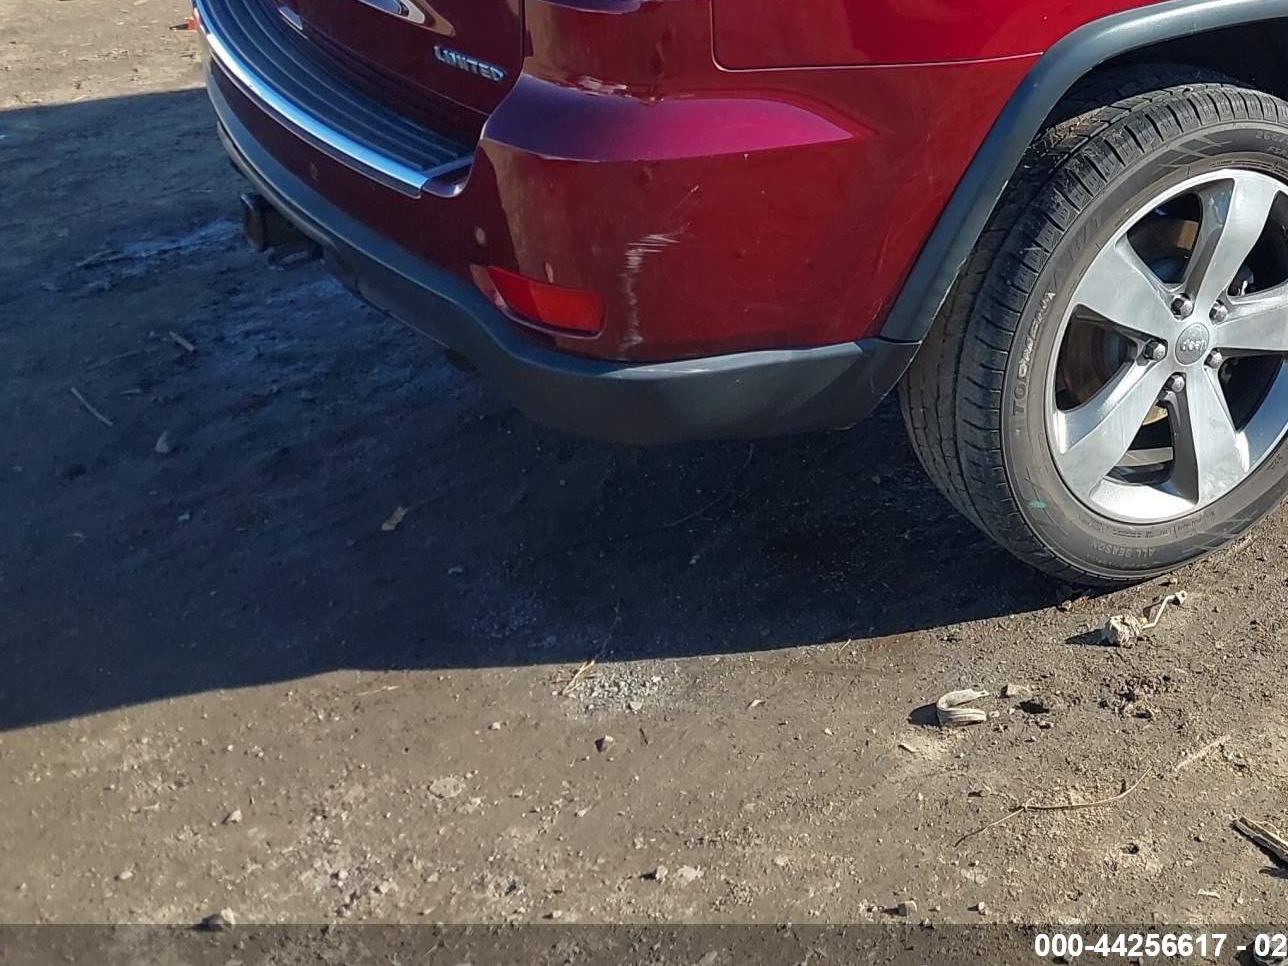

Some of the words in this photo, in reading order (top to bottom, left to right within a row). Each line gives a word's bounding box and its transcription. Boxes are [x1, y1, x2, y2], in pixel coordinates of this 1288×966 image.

[433, 45, 506, 81] LIMITED
[1088, 538, 1132, 558] SEASON
[1134, 545, 1155, 558] ALL
